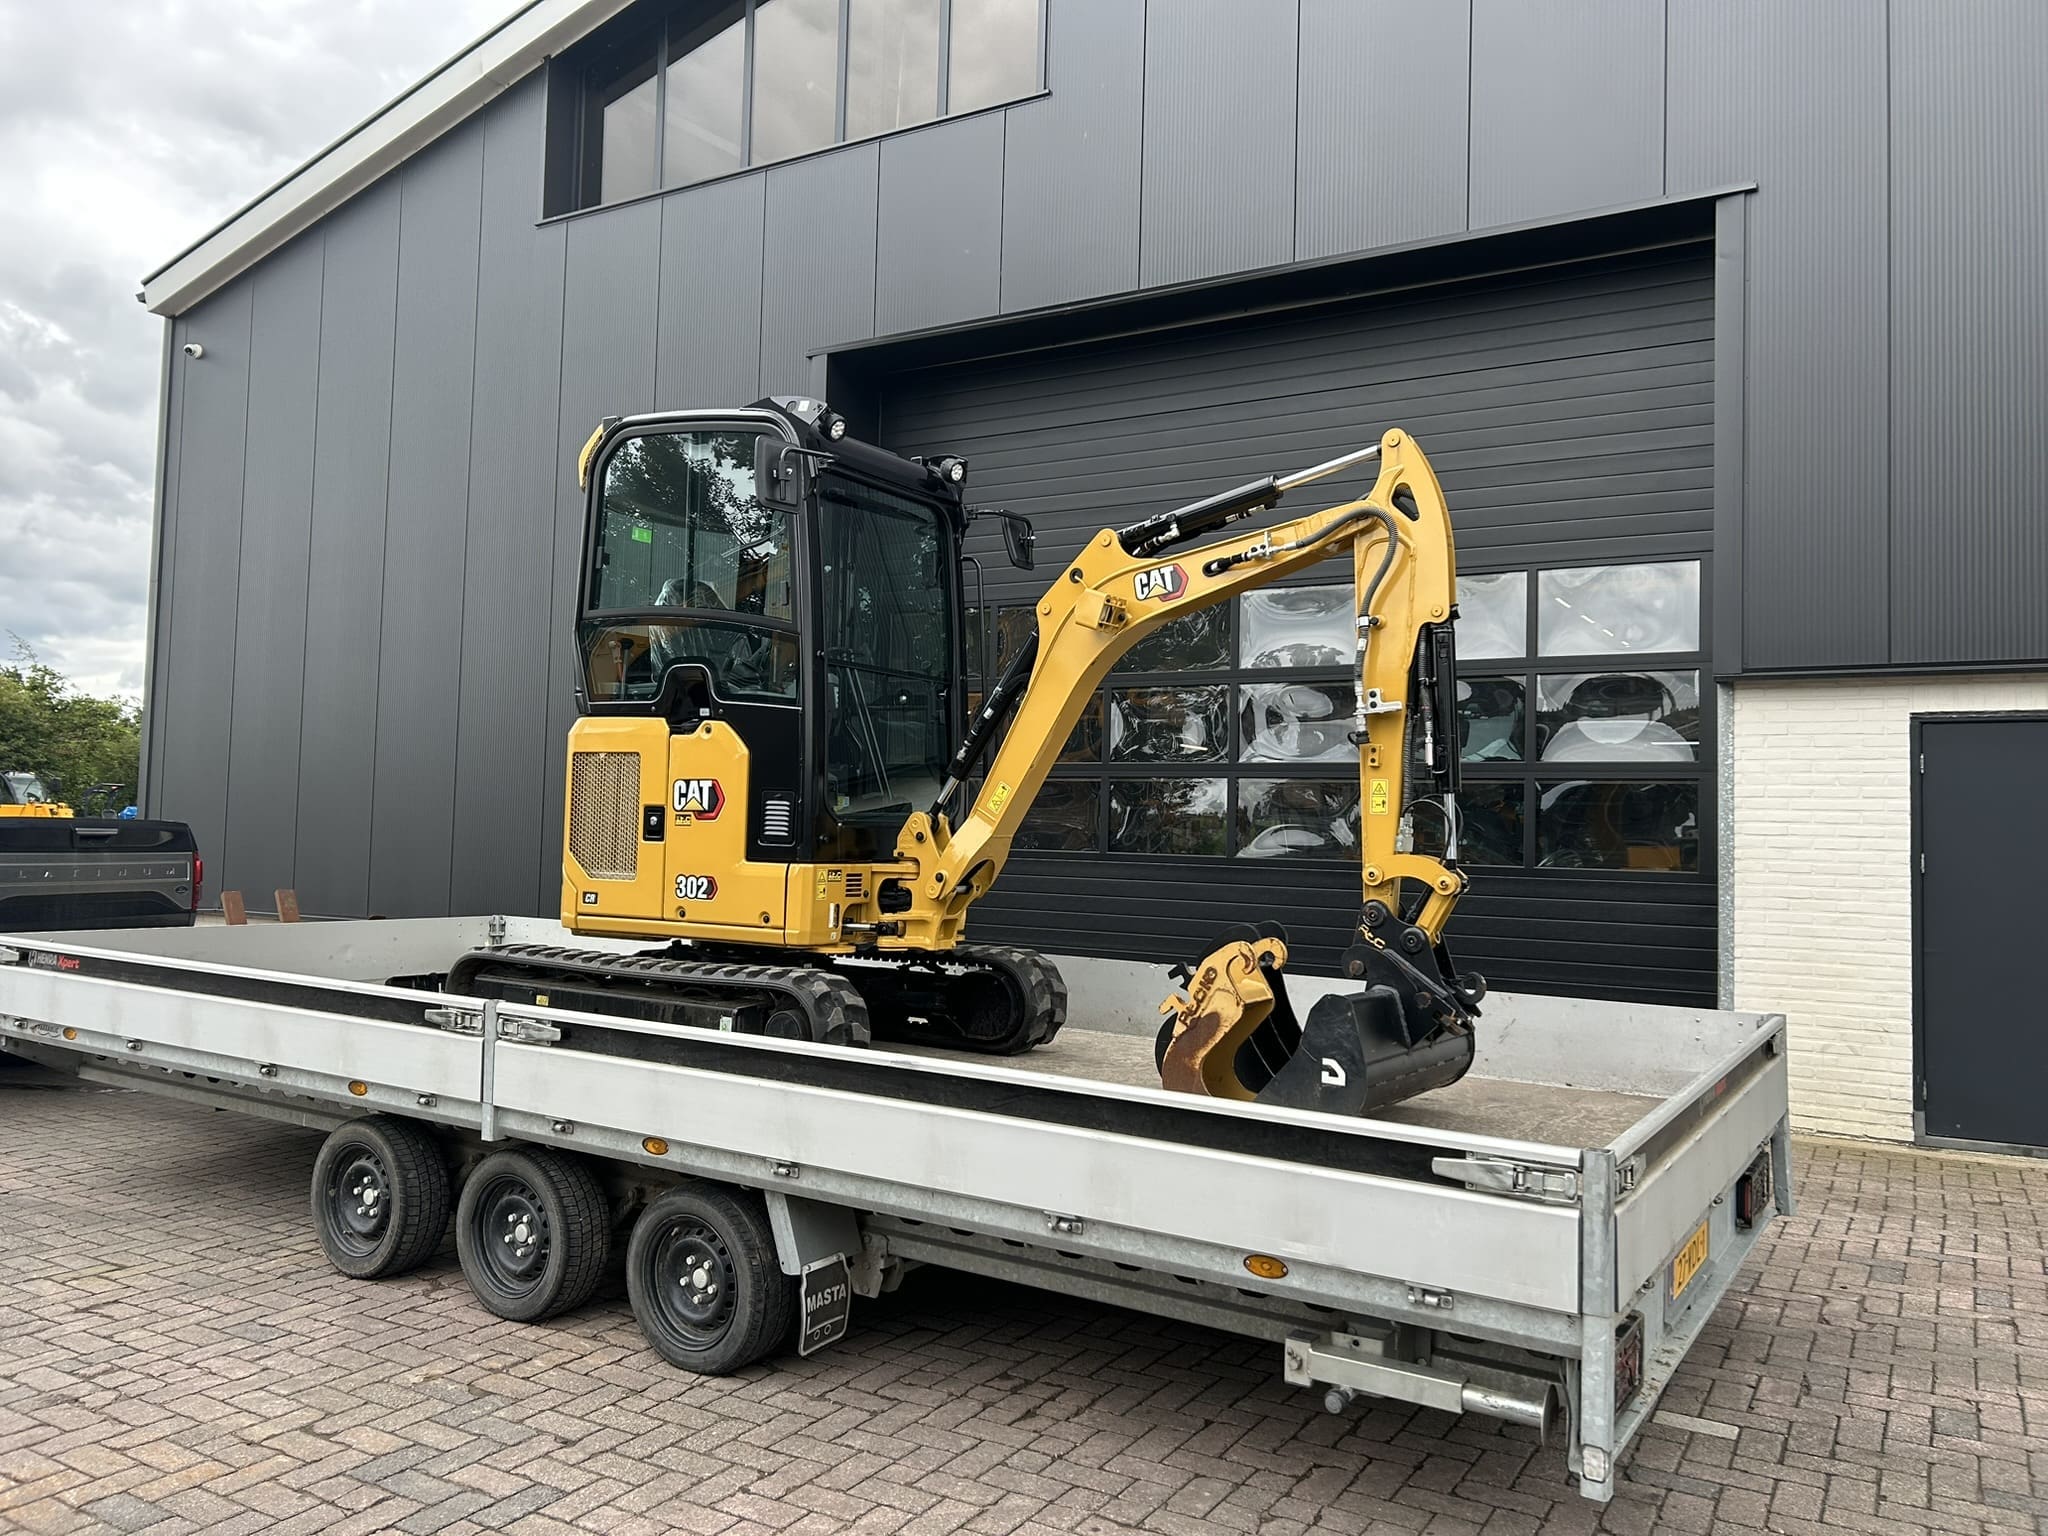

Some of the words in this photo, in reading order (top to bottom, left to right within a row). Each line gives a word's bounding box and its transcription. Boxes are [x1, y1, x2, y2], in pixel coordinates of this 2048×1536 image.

[1134, 565, 1174, 600] CAT
[674, 779, 712, 811] CAT
[676, 875, 708, 898] 302
[57, 955, 80, 970] Xpert
[807, 1283, 847, 1313] MASTA
